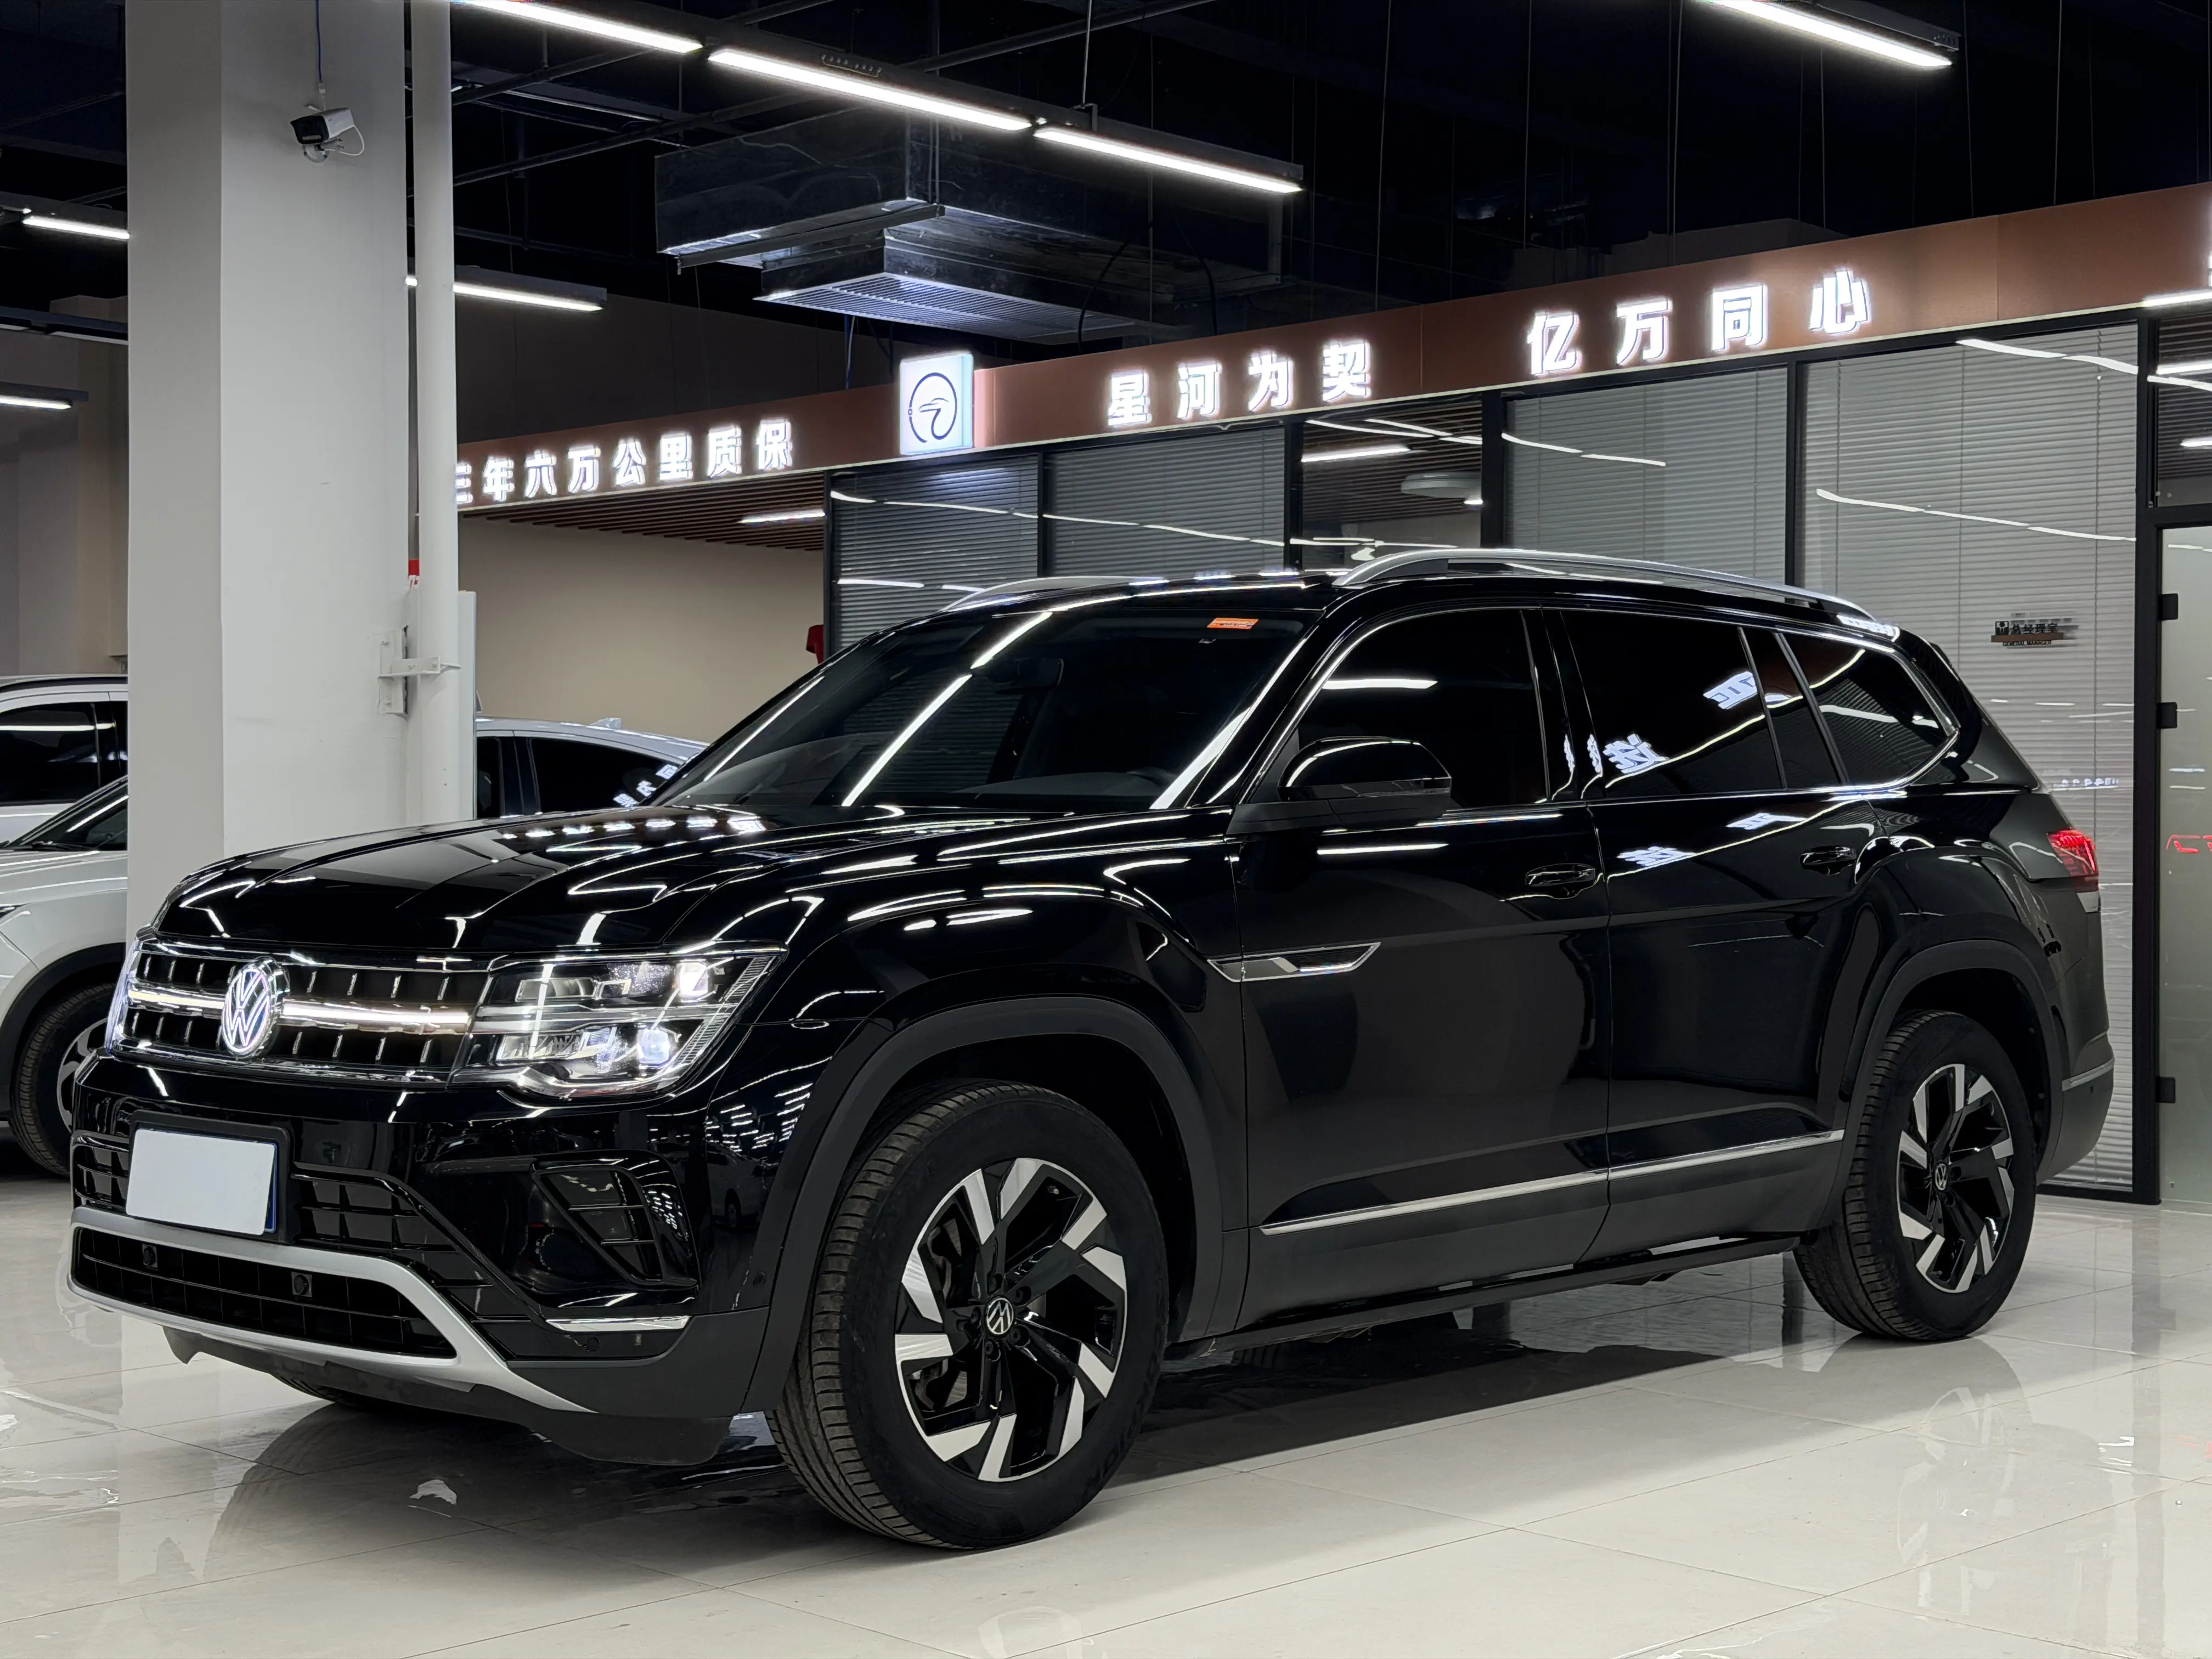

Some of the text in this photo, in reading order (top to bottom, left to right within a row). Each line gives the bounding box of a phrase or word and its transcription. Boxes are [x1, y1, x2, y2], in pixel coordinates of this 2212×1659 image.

[1108, 268, 1871, 427] 星河为契 亿万同心
